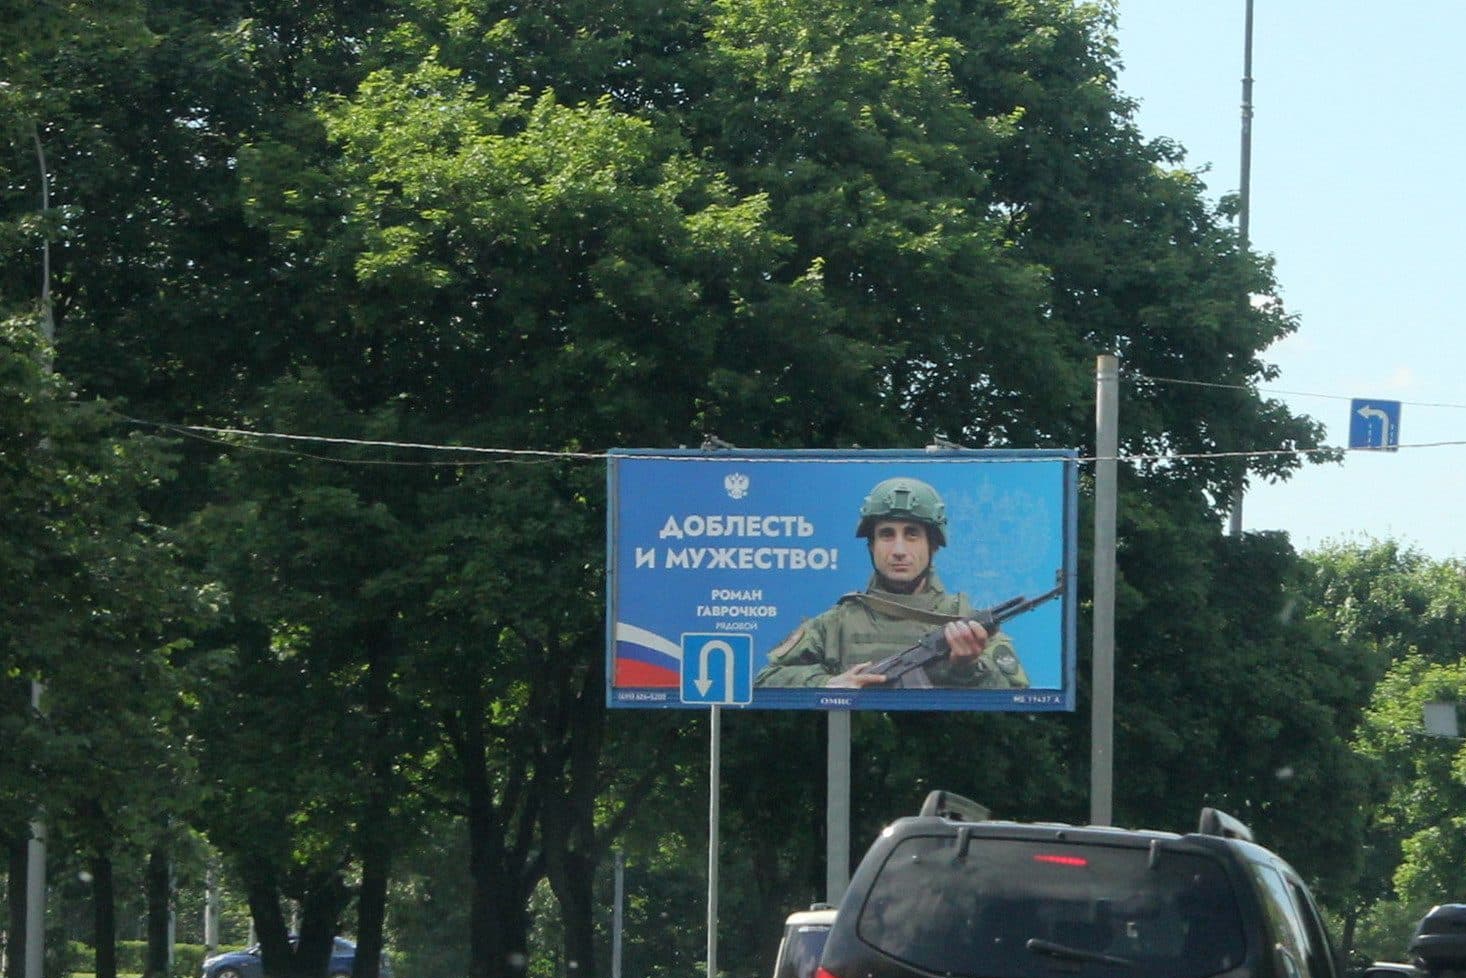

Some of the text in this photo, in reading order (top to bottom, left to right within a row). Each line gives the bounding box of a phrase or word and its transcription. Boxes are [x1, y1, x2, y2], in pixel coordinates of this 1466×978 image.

[659, 515, 814, 539] ДОБЛЕСТЬ
[635, 547, 838, 570] И МУЖЕСТВО!
[711, 589, 762, 601] РОМАН
[697, 605, 777, 617] ГАВРОЧКОВ
